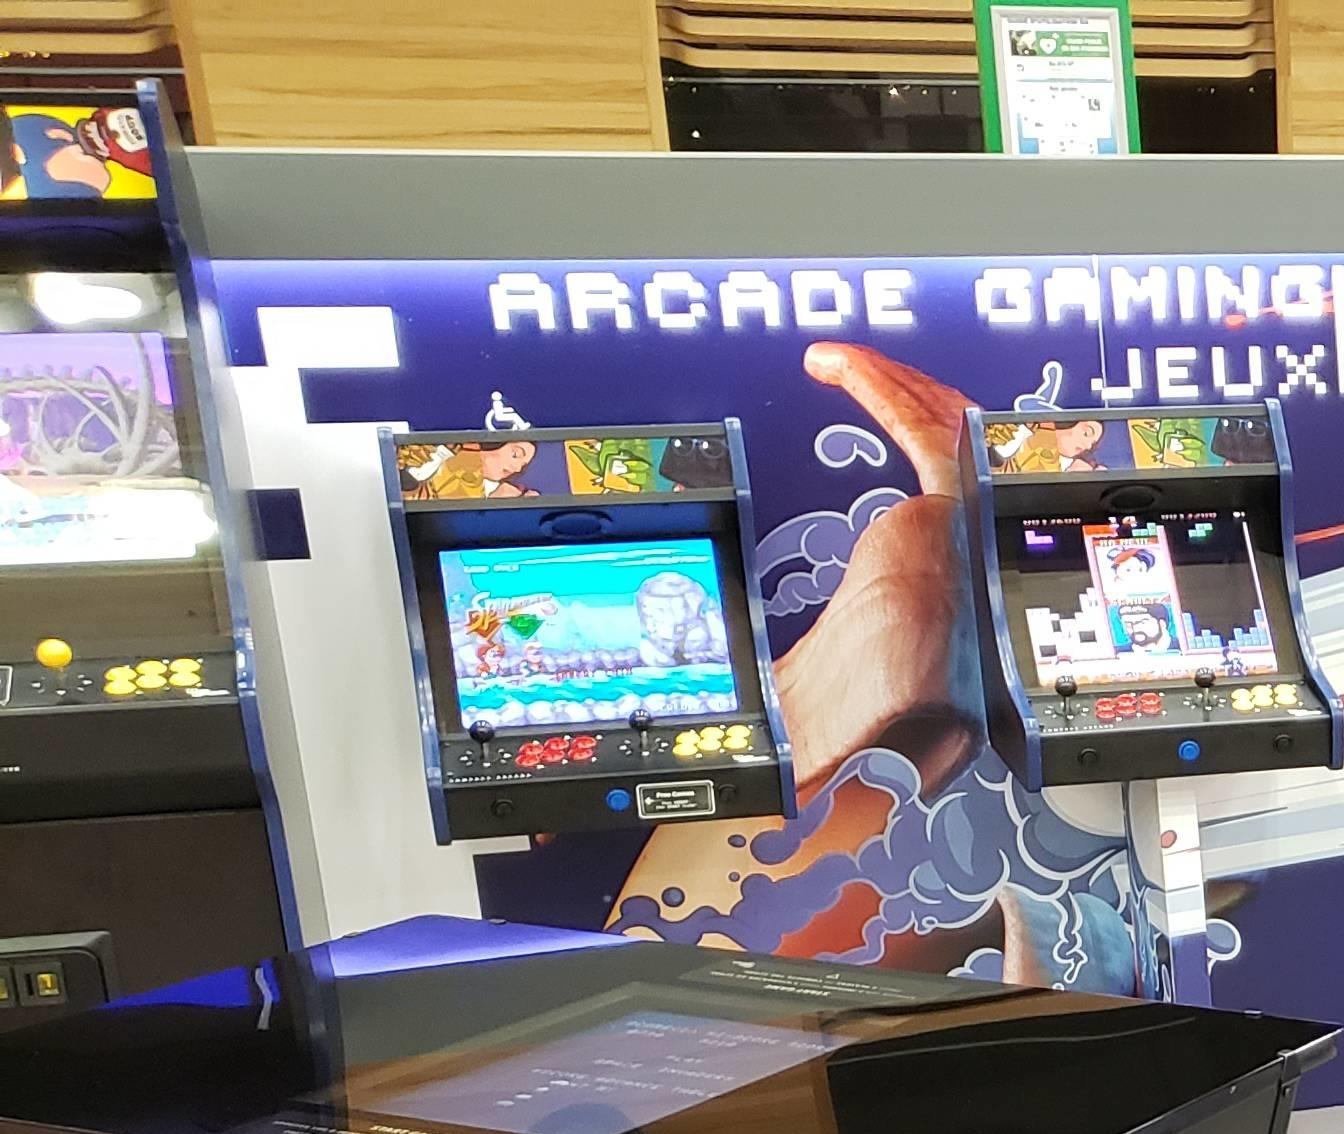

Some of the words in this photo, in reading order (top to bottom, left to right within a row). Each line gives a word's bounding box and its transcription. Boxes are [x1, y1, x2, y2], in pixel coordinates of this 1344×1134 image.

[488, 267, 914, 331] ARCADE
[975, 264, 1331, 323] GAMING
[1092, 344, 1327, 398] JEUX
